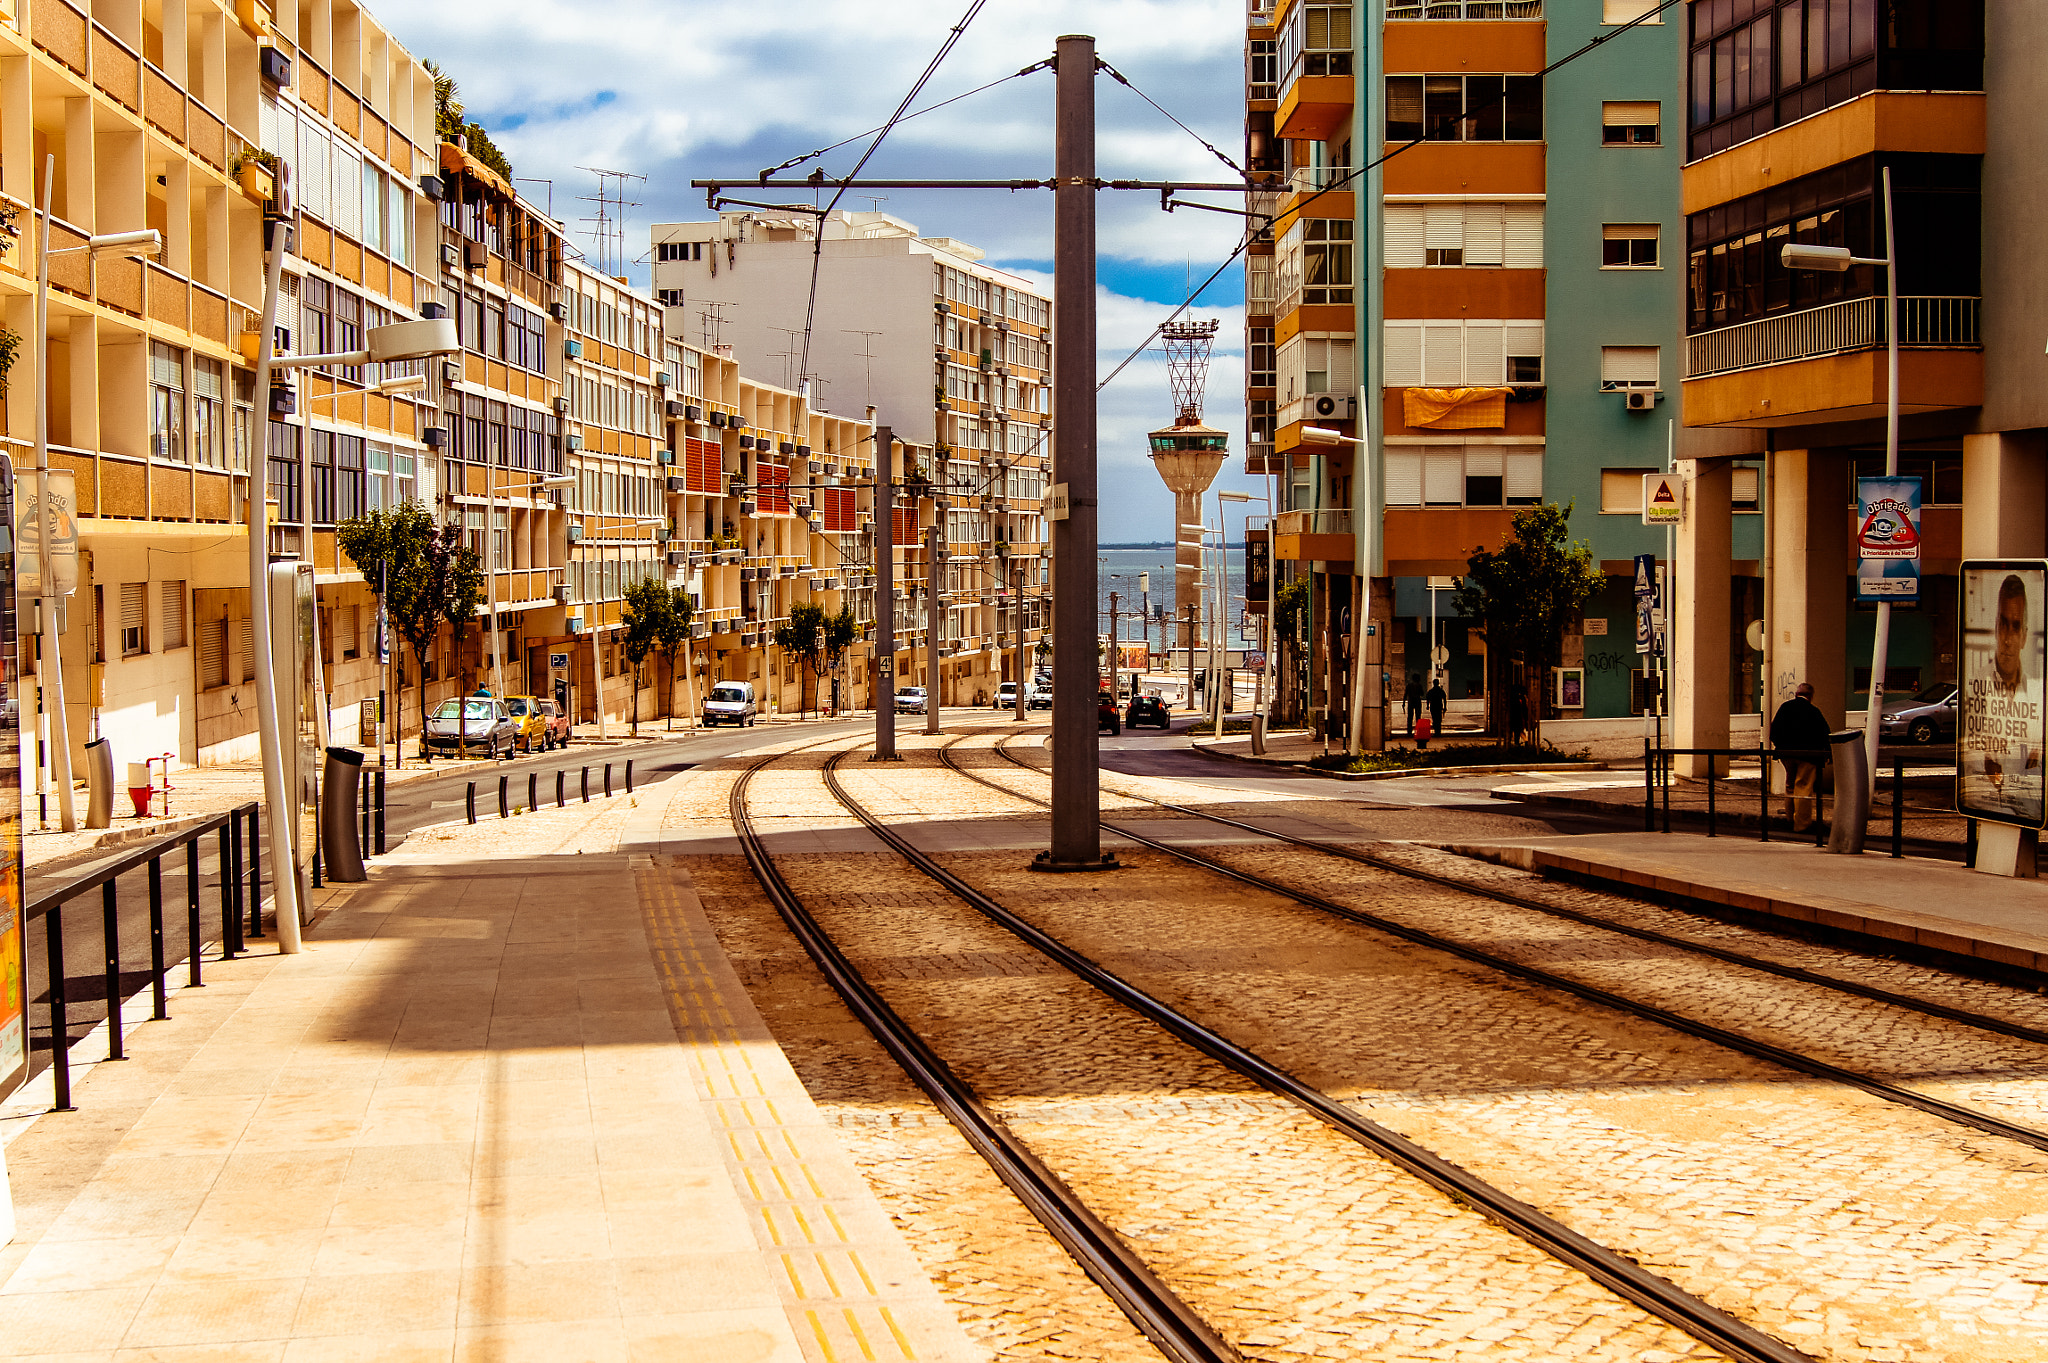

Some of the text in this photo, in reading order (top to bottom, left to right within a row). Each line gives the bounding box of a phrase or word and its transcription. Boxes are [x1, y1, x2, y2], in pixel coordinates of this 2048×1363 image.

[1649, 507, 1658, 516] City
[1866, 500, 1910, 514] Obrigado
[552, 655, 560, 666] P
[1968, 697, 2039, 721] FOR GRANDE,
[1967, 715, 2028, 737] QUERO SER
